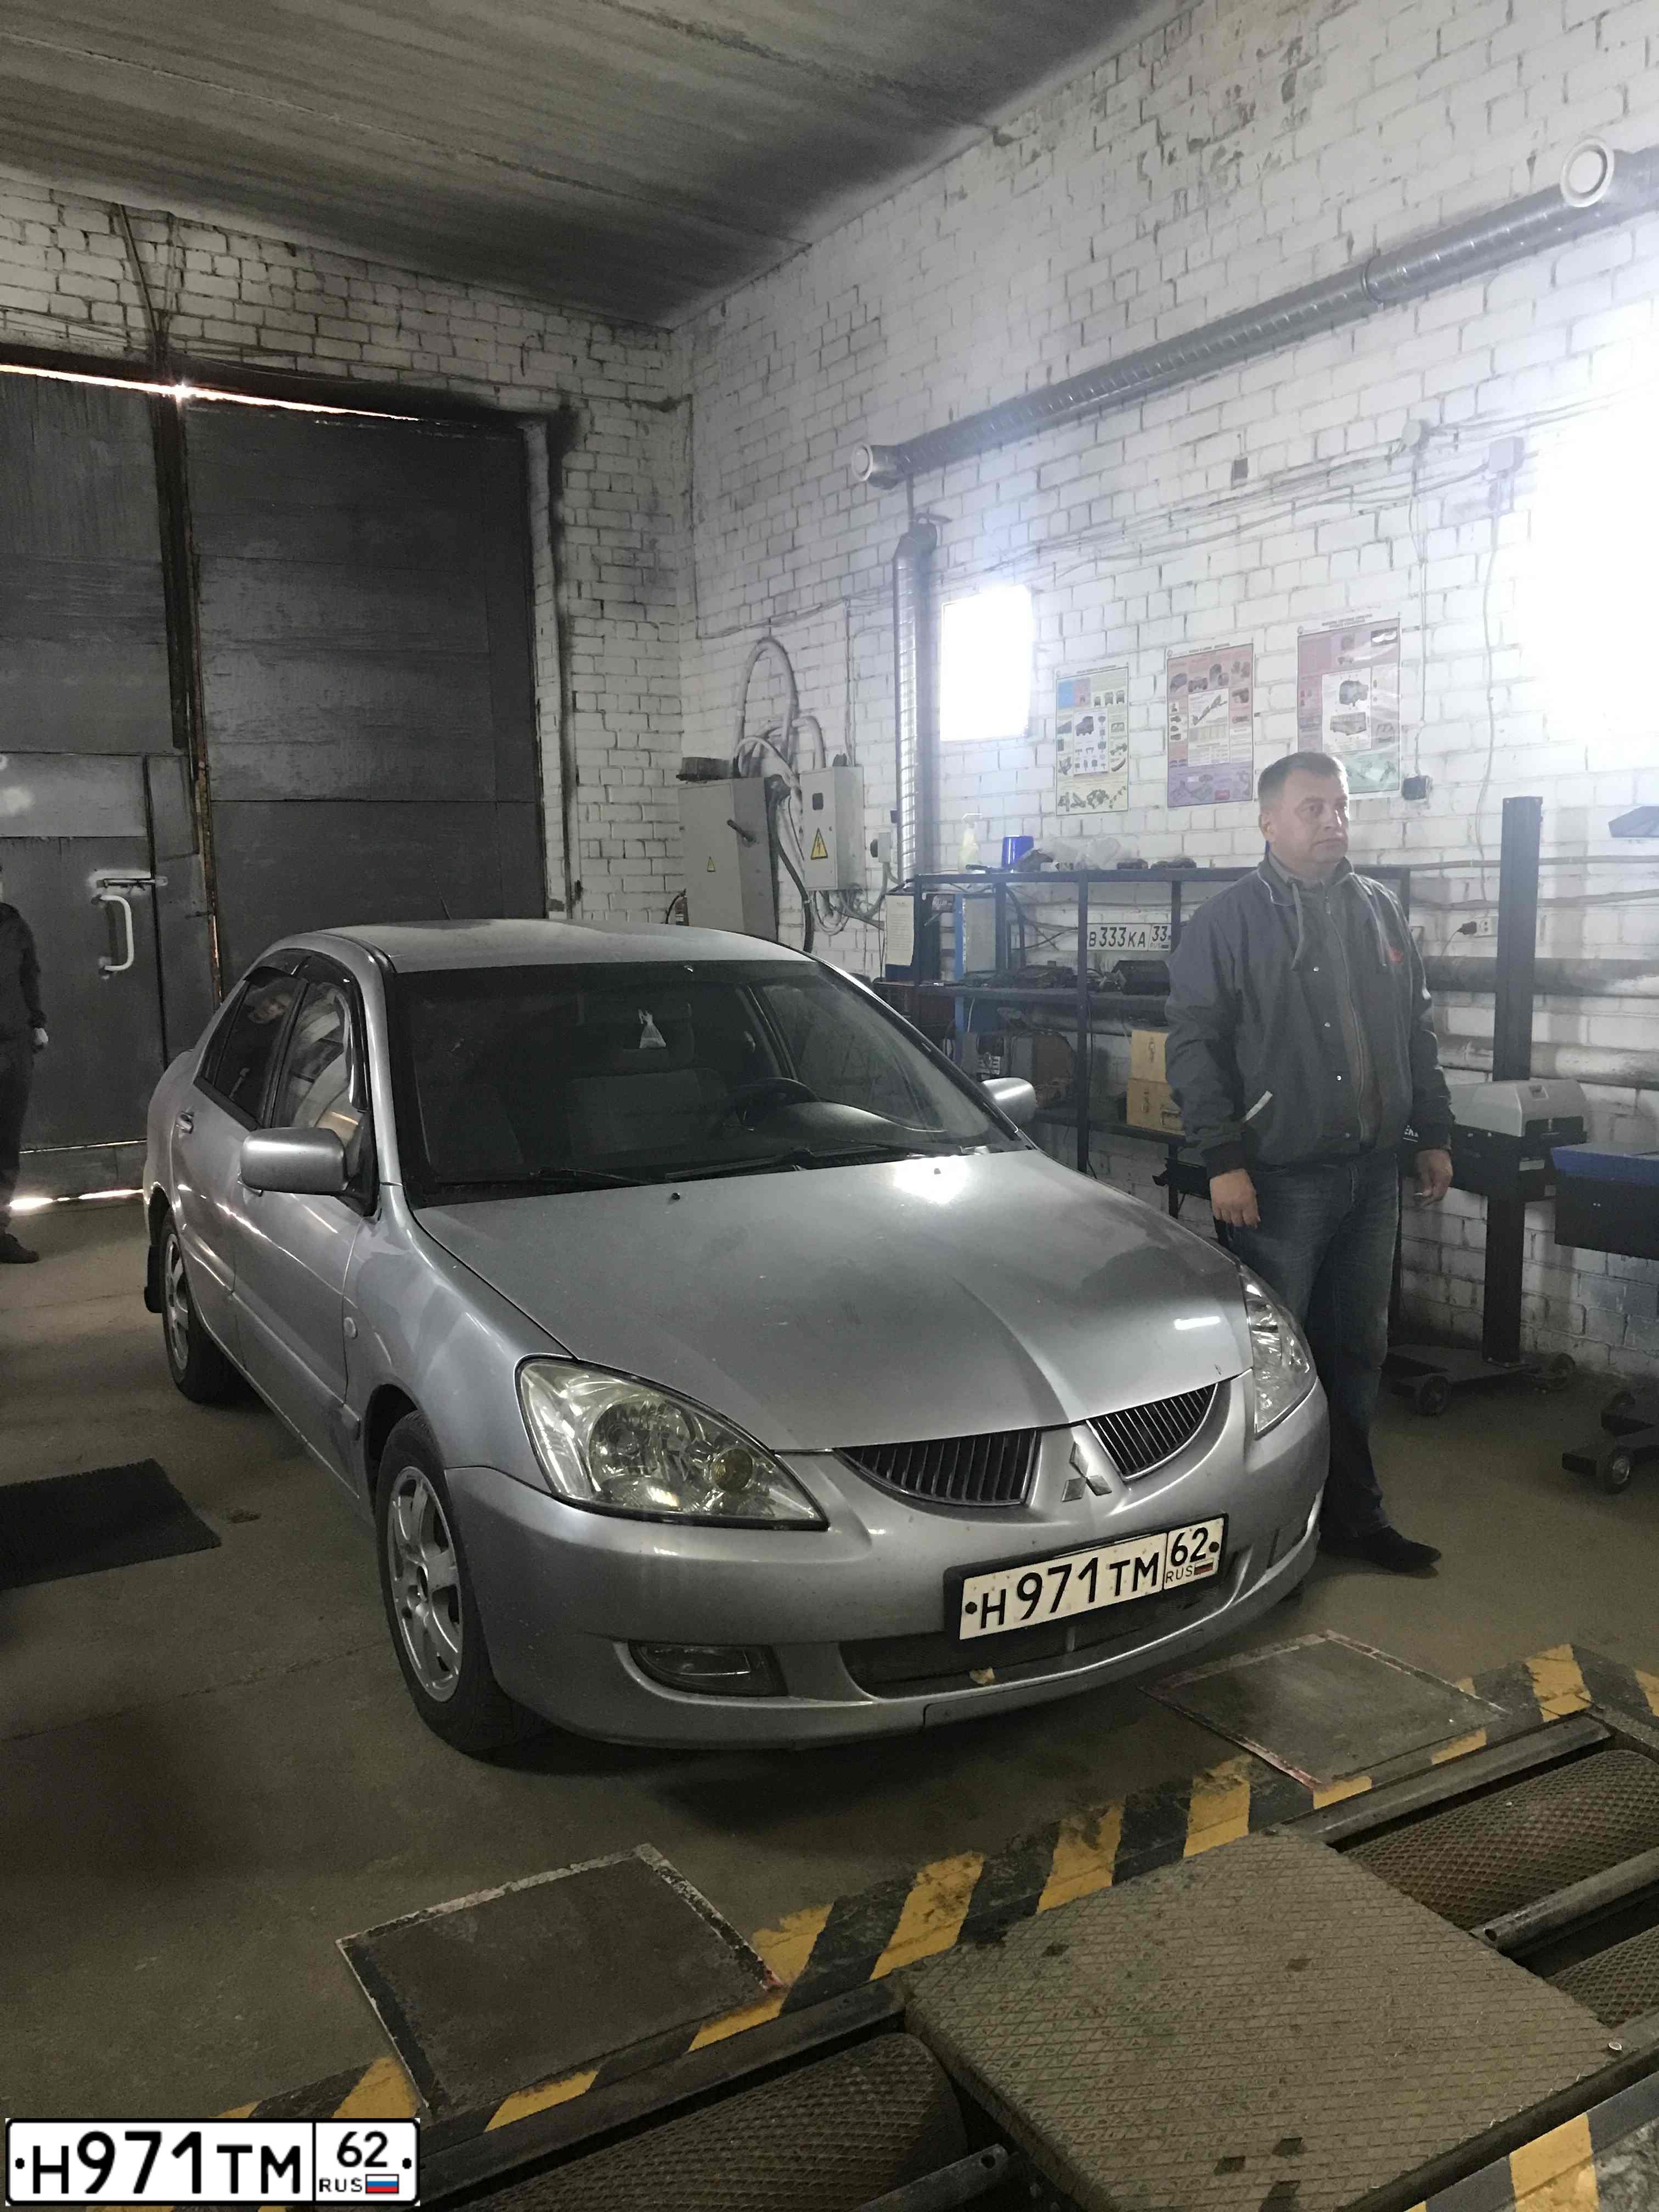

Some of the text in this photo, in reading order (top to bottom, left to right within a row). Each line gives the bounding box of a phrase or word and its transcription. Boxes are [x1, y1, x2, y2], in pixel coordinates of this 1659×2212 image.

[1152, 926, 1167, 942] 33
[1171, 1527, 1208, 1566] 62
[1166, 1565, 1194, 1583] RUS
